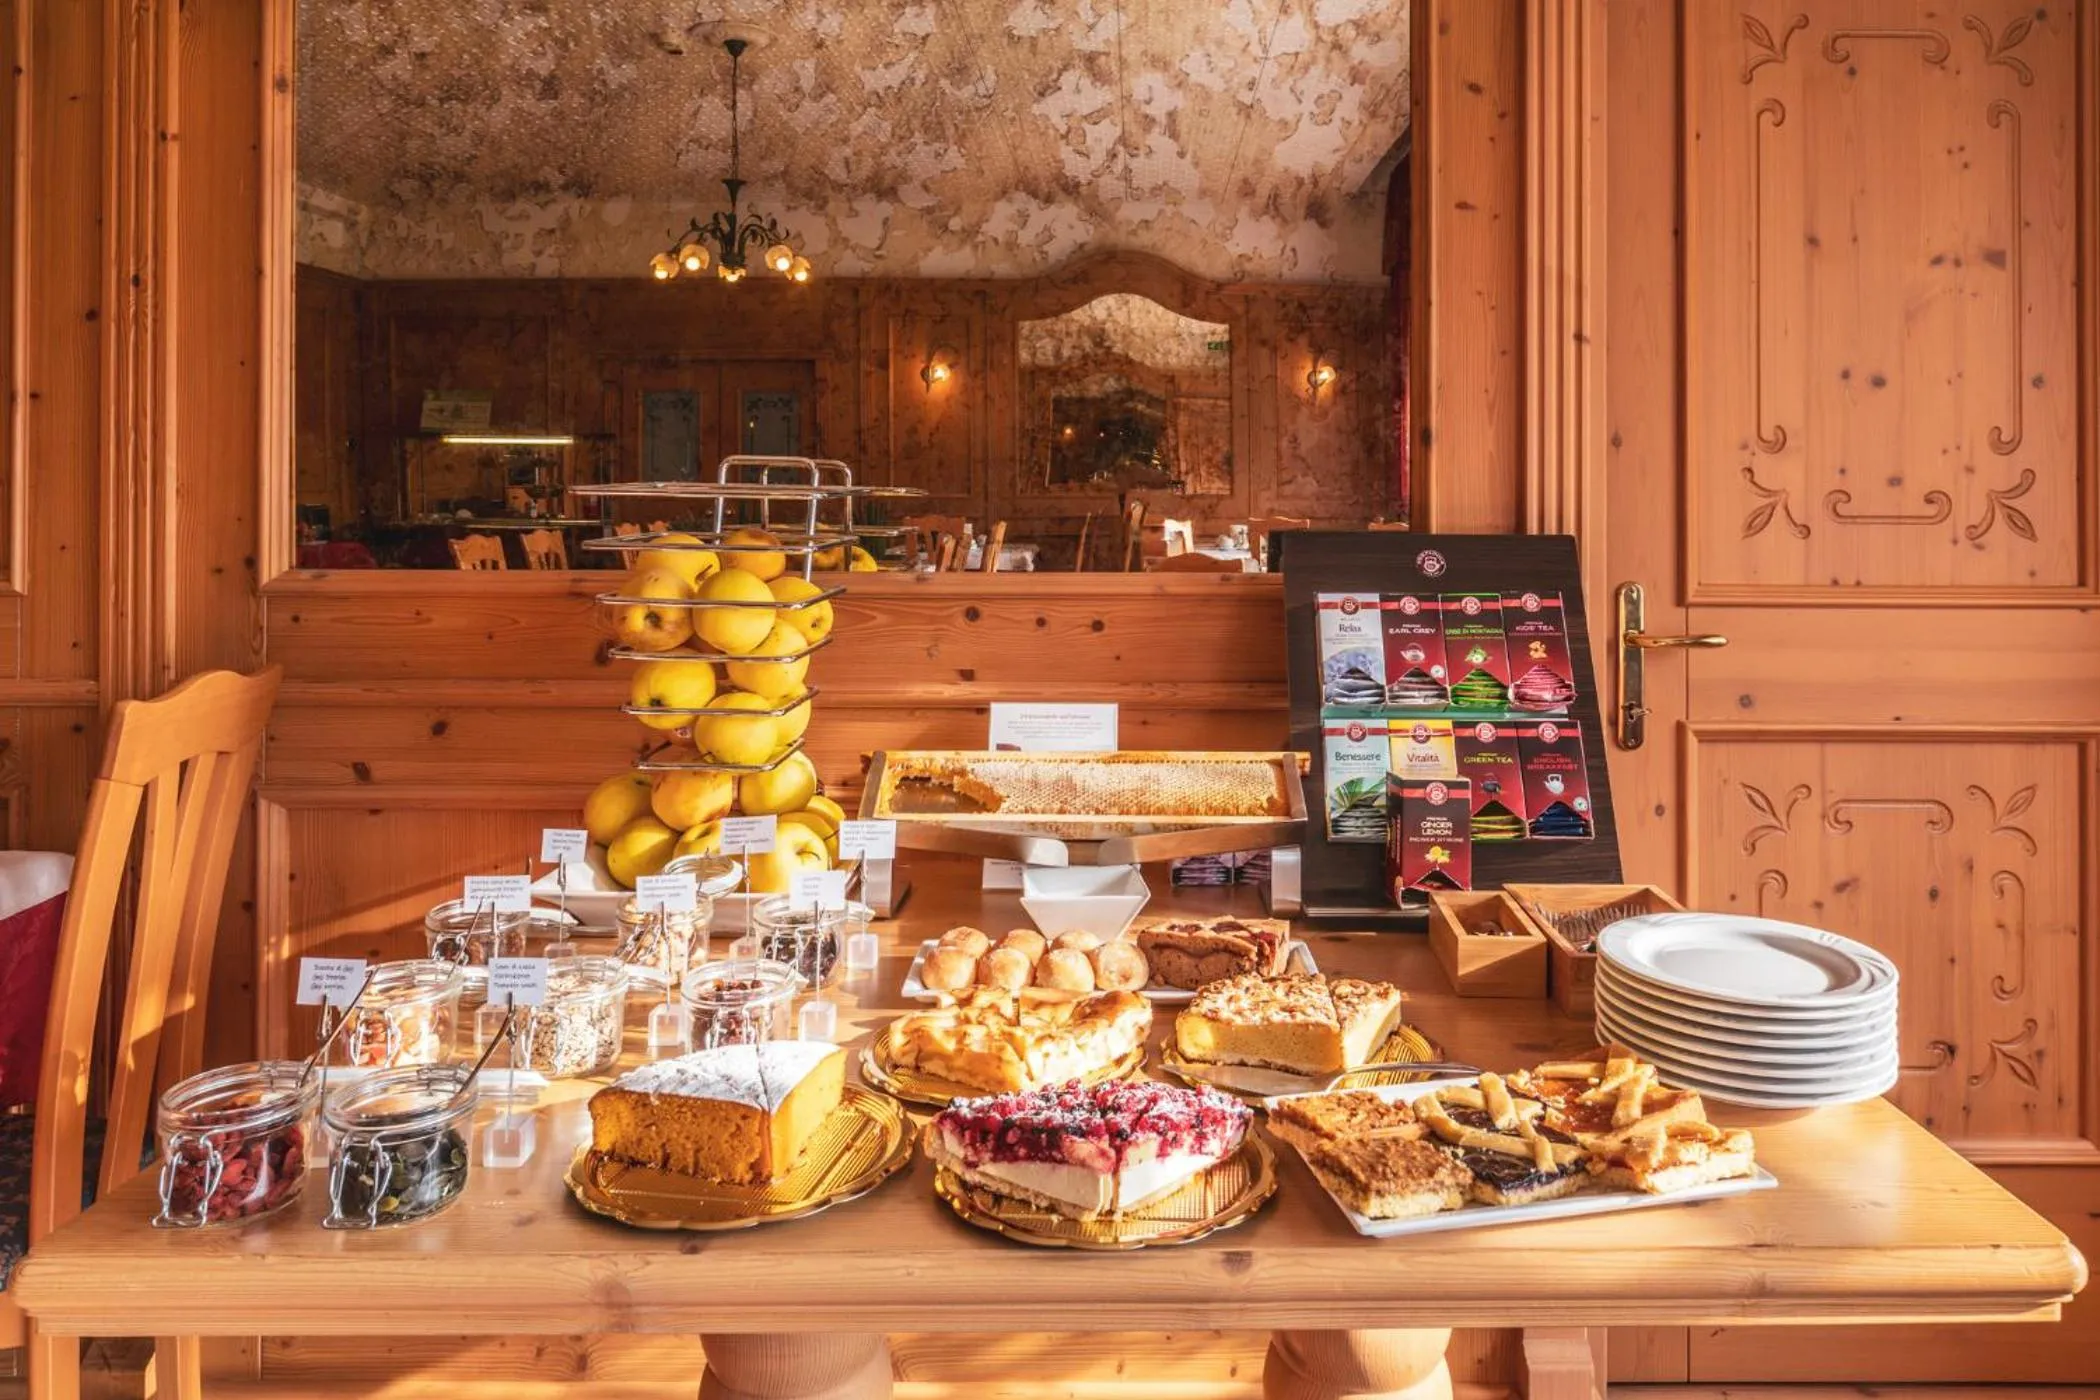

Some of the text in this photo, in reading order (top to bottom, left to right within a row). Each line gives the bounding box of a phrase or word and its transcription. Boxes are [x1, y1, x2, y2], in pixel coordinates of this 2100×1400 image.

[1339, 623, 1362, 633] Relax
[1335, 751, 1381, 761] Benessere
[1463, 756, 1514, 764] GREEN TEA
[1420, 821, 1453, 829] GINGER
[1421, 828, 1452, 836] LEMON
